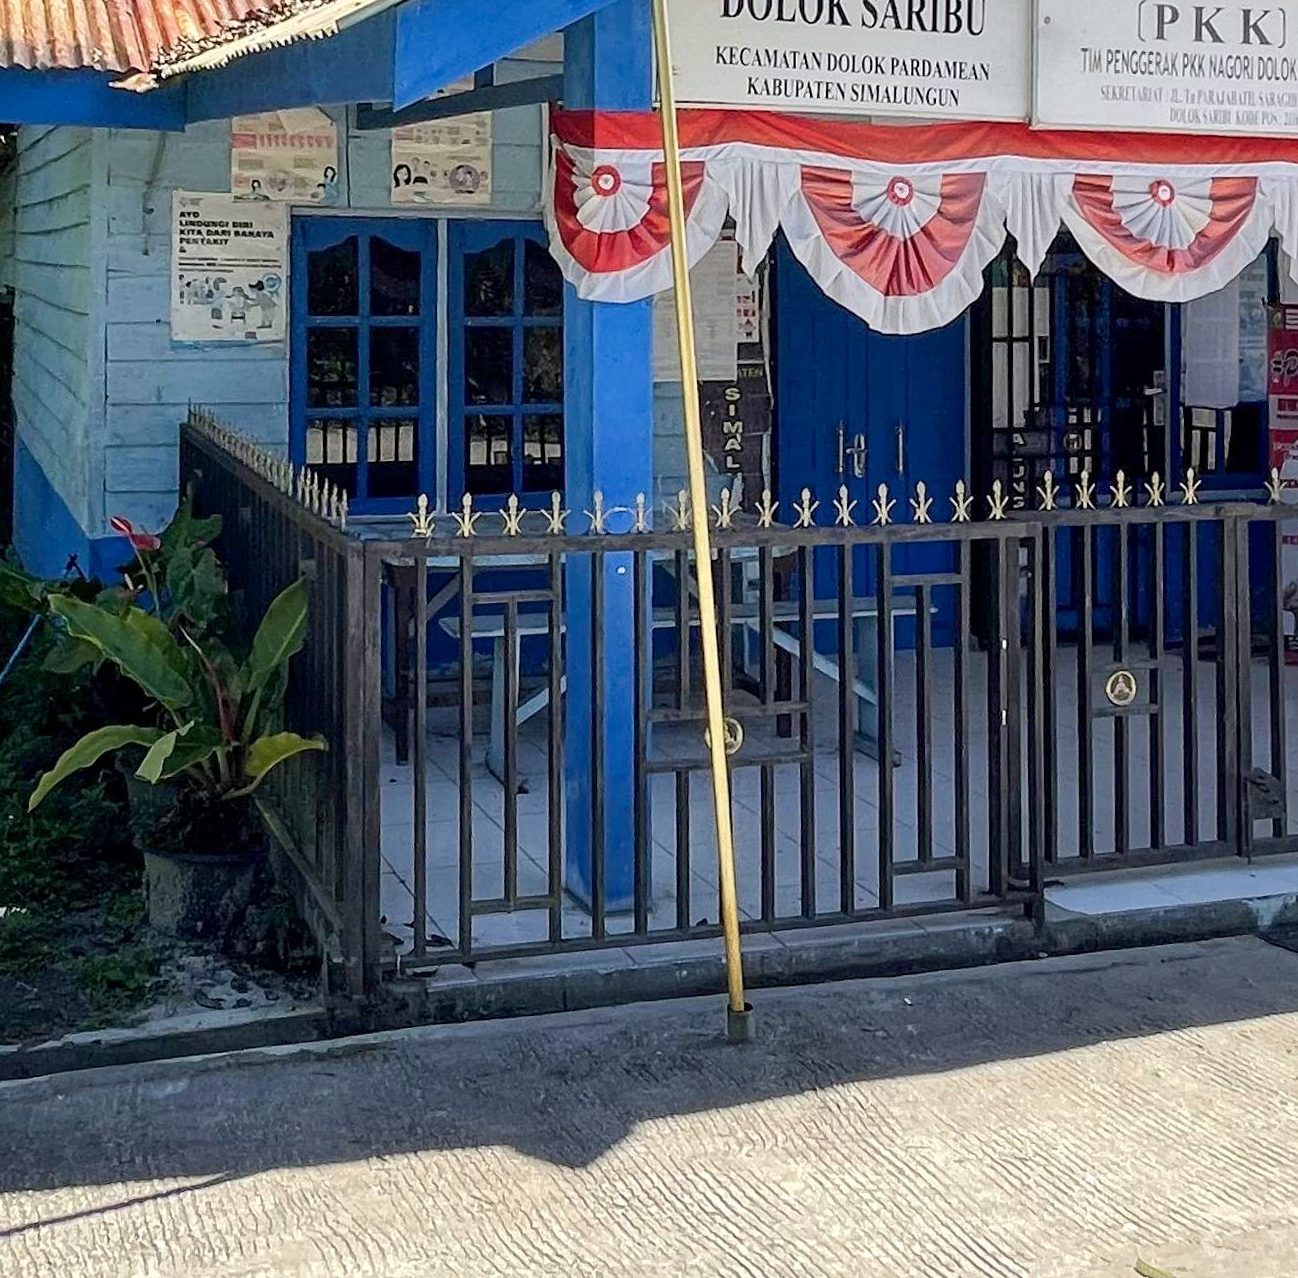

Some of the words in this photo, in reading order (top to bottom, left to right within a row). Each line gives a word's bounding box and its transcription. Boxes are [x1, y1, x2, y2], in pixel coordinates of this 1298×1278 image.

[715, 45, 822, 70] KECAMATAN
[827, 53, 885, 75] DOLOK
[890, 57, 990, 81] PARDAMEAN
[1080, 48, 1102, 73] TIM
[1105, 49, 1179, 76] PENGGERAK
[1182, 52, 1205, 77] PKK
[1208, 55, 1254, 79] NAGORI
[1257, 56, 1298, 81] DOLOK
[747, 77, 846, 101] KABUPATEN
[851, 84, 960, 108] SIMALUNGUN
